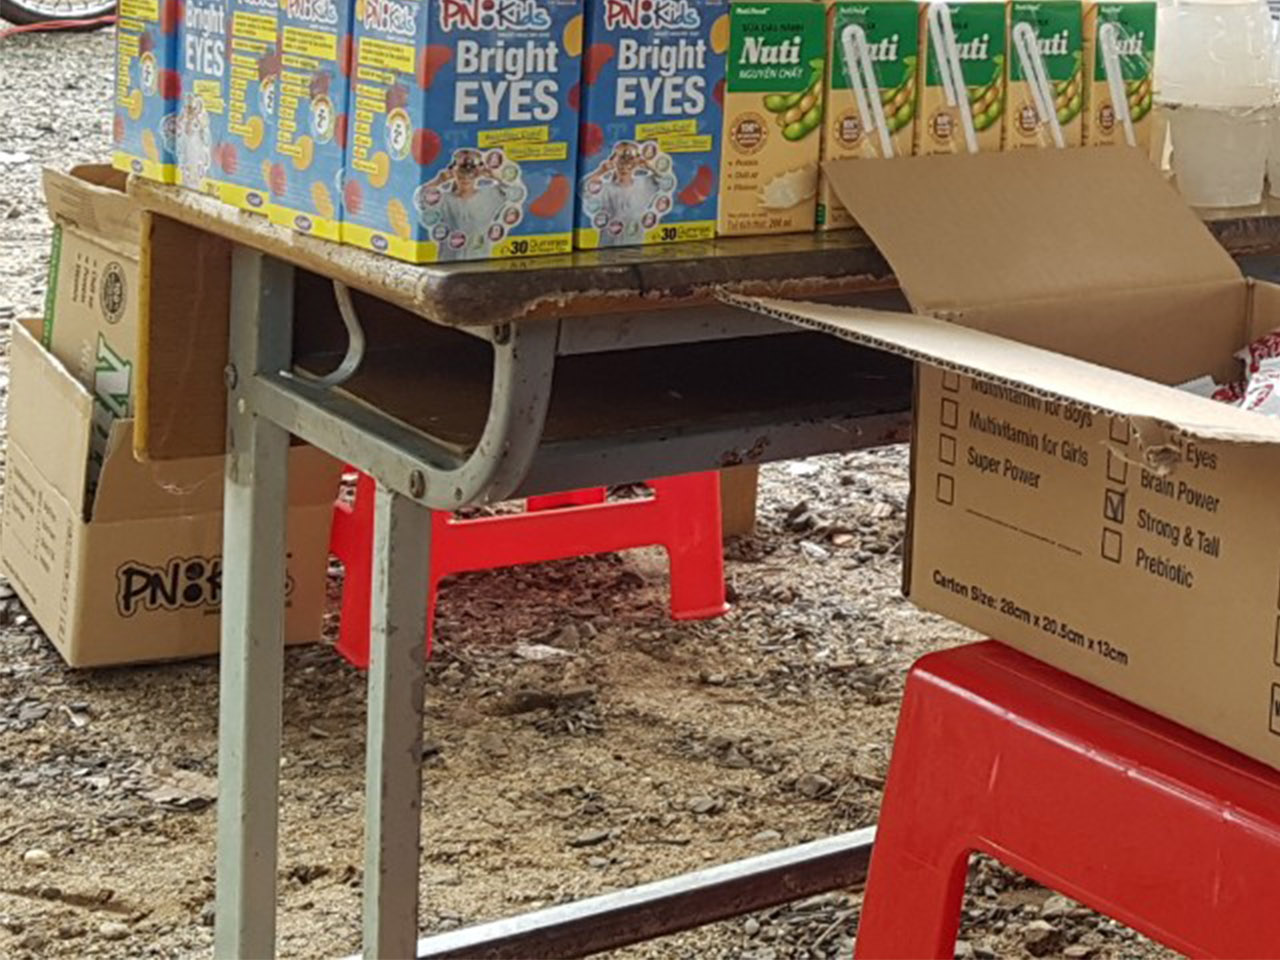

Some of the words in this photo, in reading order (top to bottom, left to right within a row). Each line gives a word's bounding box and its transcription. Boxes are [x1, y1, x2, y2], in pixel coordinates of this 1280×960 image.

[185, 0, 225, 36] Bright
[185, 34, 225, 77] EYES
[456, 39, 558, 79] Bright
[617, 38, 705, 77] Bright
[738, 36, 802, 65] Nuti
[865, 33, 899, 61] uti
[954, 33, 989, 60] uti
[1036, 29, 1068, 55] uti
[453, 78, 559, 123] EYES
[615, 76, 705, 117] EYES
[510, 240, 528, 255] 30
[661, 226, 677, 240] 30
[969, 410, 1039, 451] Multivitamin
[1042, 434, 1058, 456] for
[1061, 440, 1088, 467] Girls
[1186, 442, 1217, 470] Eyes
[967, 446, 1001, 473] Super
[1003, 458, 1040, 488] Power
[1140, 468, 1175, 499] Brain
[1177, 481, 1219, 513] Power
[1137, 508, 1180, 546] Strong
[1183, 526, 1194, 547] &
[1197, 530, 1220, 558] Tall
[1136, 547, 1194, 588] Prebiotic
[933, 569, 968, 598] Carton
[971, 585, 997, 609] Size:
[1000, 597, 1031, 624] 28cm
[1033, 614, 1041, 628] x
[1043, 616, 1085, 648] 20.5cm
[1087, 638, 1095, 652] x
[1097, 639, 1129, 666] 13cm
